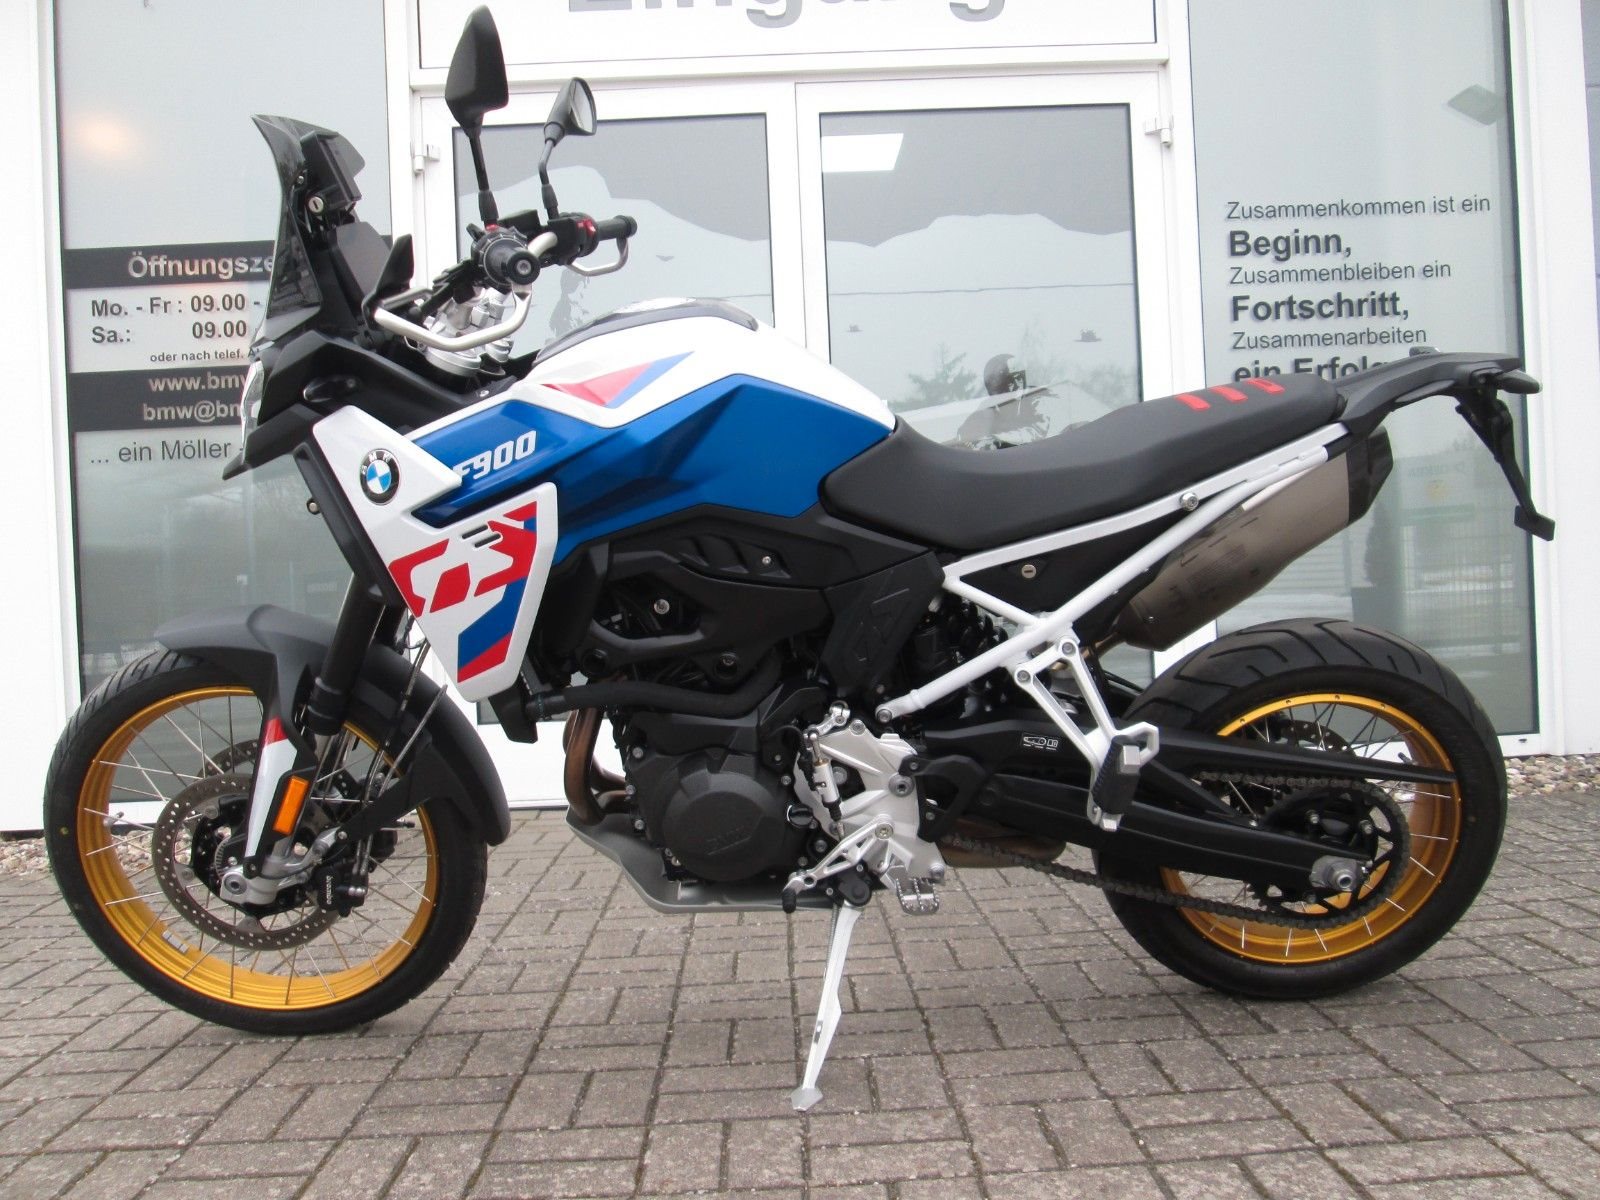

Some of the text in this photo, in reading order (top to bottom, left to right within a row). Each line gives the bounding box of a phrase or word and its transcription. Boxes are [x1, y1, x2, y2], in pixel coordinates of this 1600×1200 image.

[1227, 195, 1491, 219] Zusammenkommen ist ein
[1229, 229, 1352, 262] Beginn,
[1230, 260, 1451, 284] Zusammenbleiben ein
[91, 299, 128, 317] Mo.
[150, 297, 171, 313] Fr
[190, 293, 246, 313] 09.00
[1232, 291, 1409, 321] Fortschritt,
[92, 320, 247, 344] Sa.: 09.00
[1233, 327, 1427, 349] Zusammenarbeiten
[150, 352, 176, 362] oder
[181, 350, 210, 361] nach
[215, 349, 243, 360] telef.
[1294, 355, 1389, 381] Erfol
[118, 442, 152, 462] ein
[161, 439, 232, 460] Möller
[453, 430, 536, 480] F900
